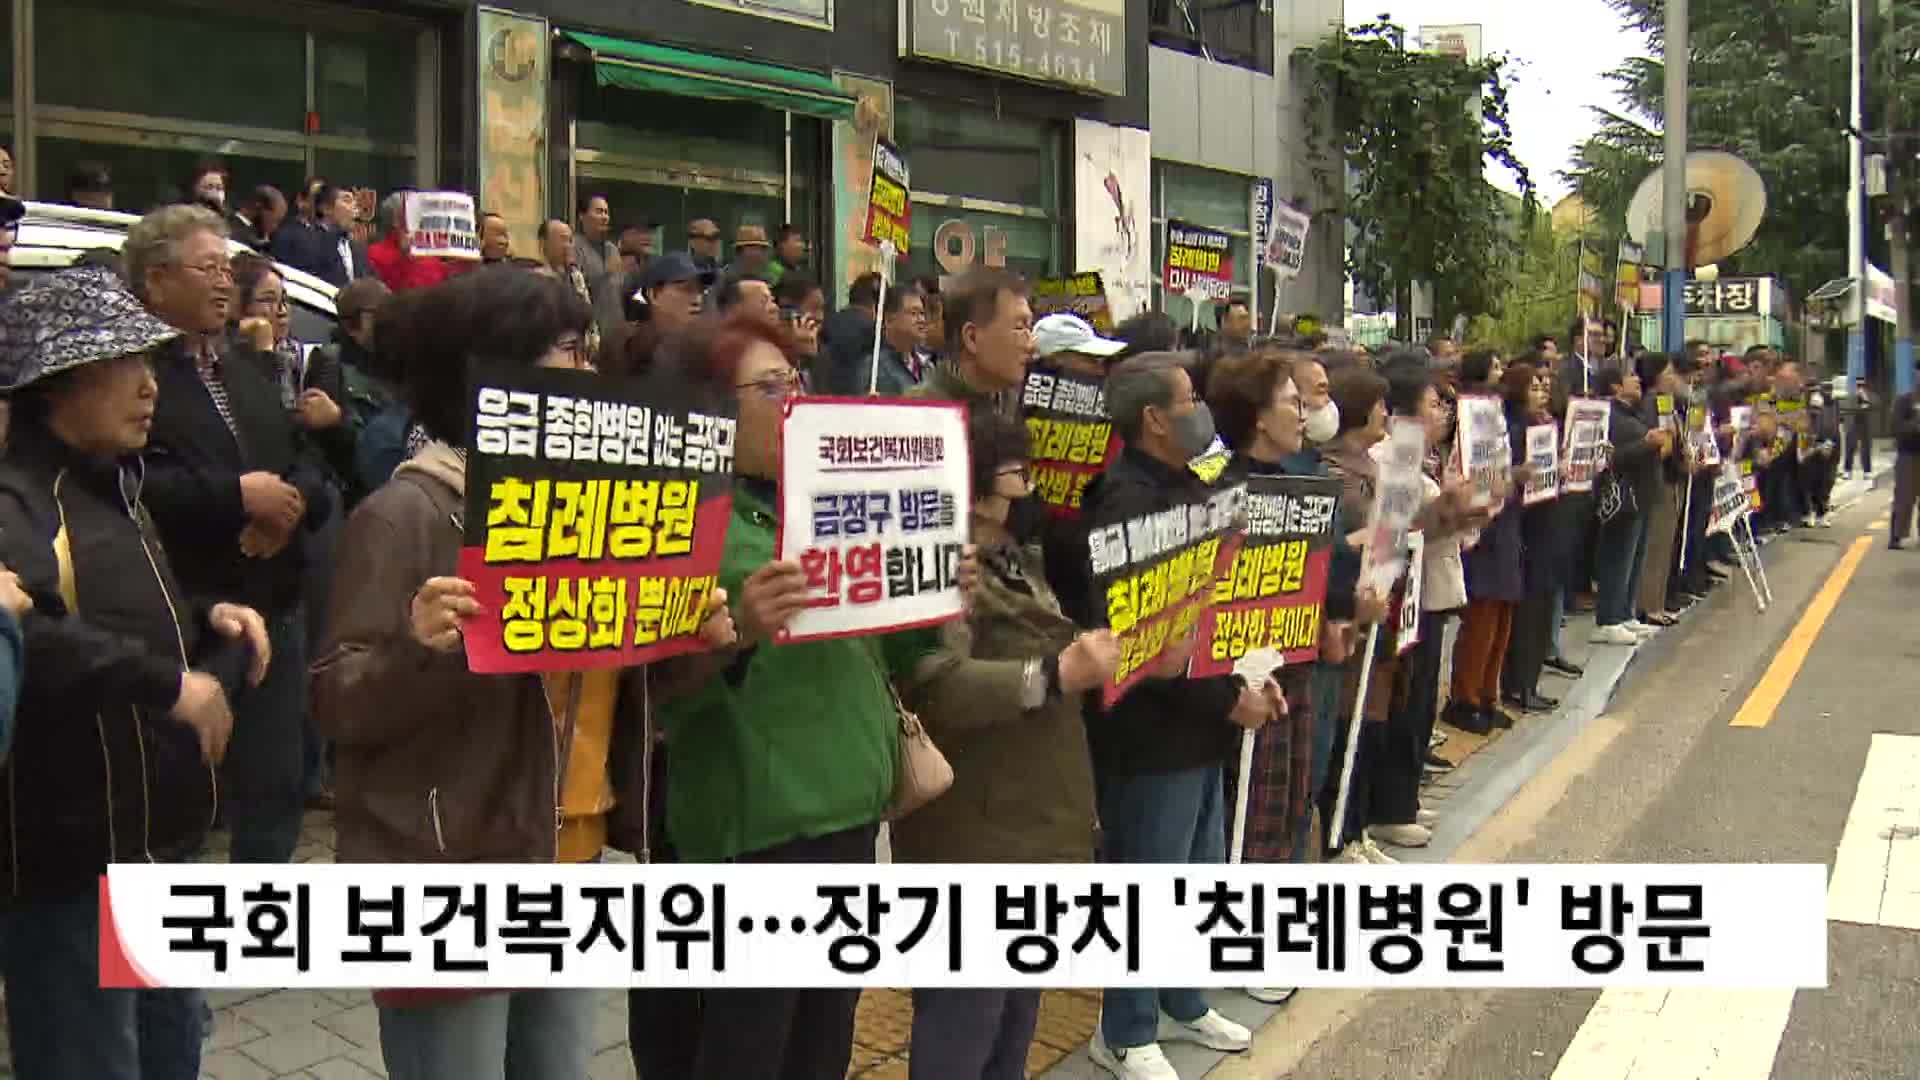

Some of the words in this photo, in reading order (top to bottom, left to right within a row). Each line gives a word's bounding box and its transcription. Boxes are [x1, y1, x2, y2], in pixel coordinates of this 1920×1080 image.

[944, 29, 959, 56] T
[477, 386, 540, 457] 응급
[544, 395, 651, 466] 종합병원
[484, 476, 700, 563] 침례병원
[813, 491, 893, 537] 금정구
[502, 575, 628, 651] 정상화
